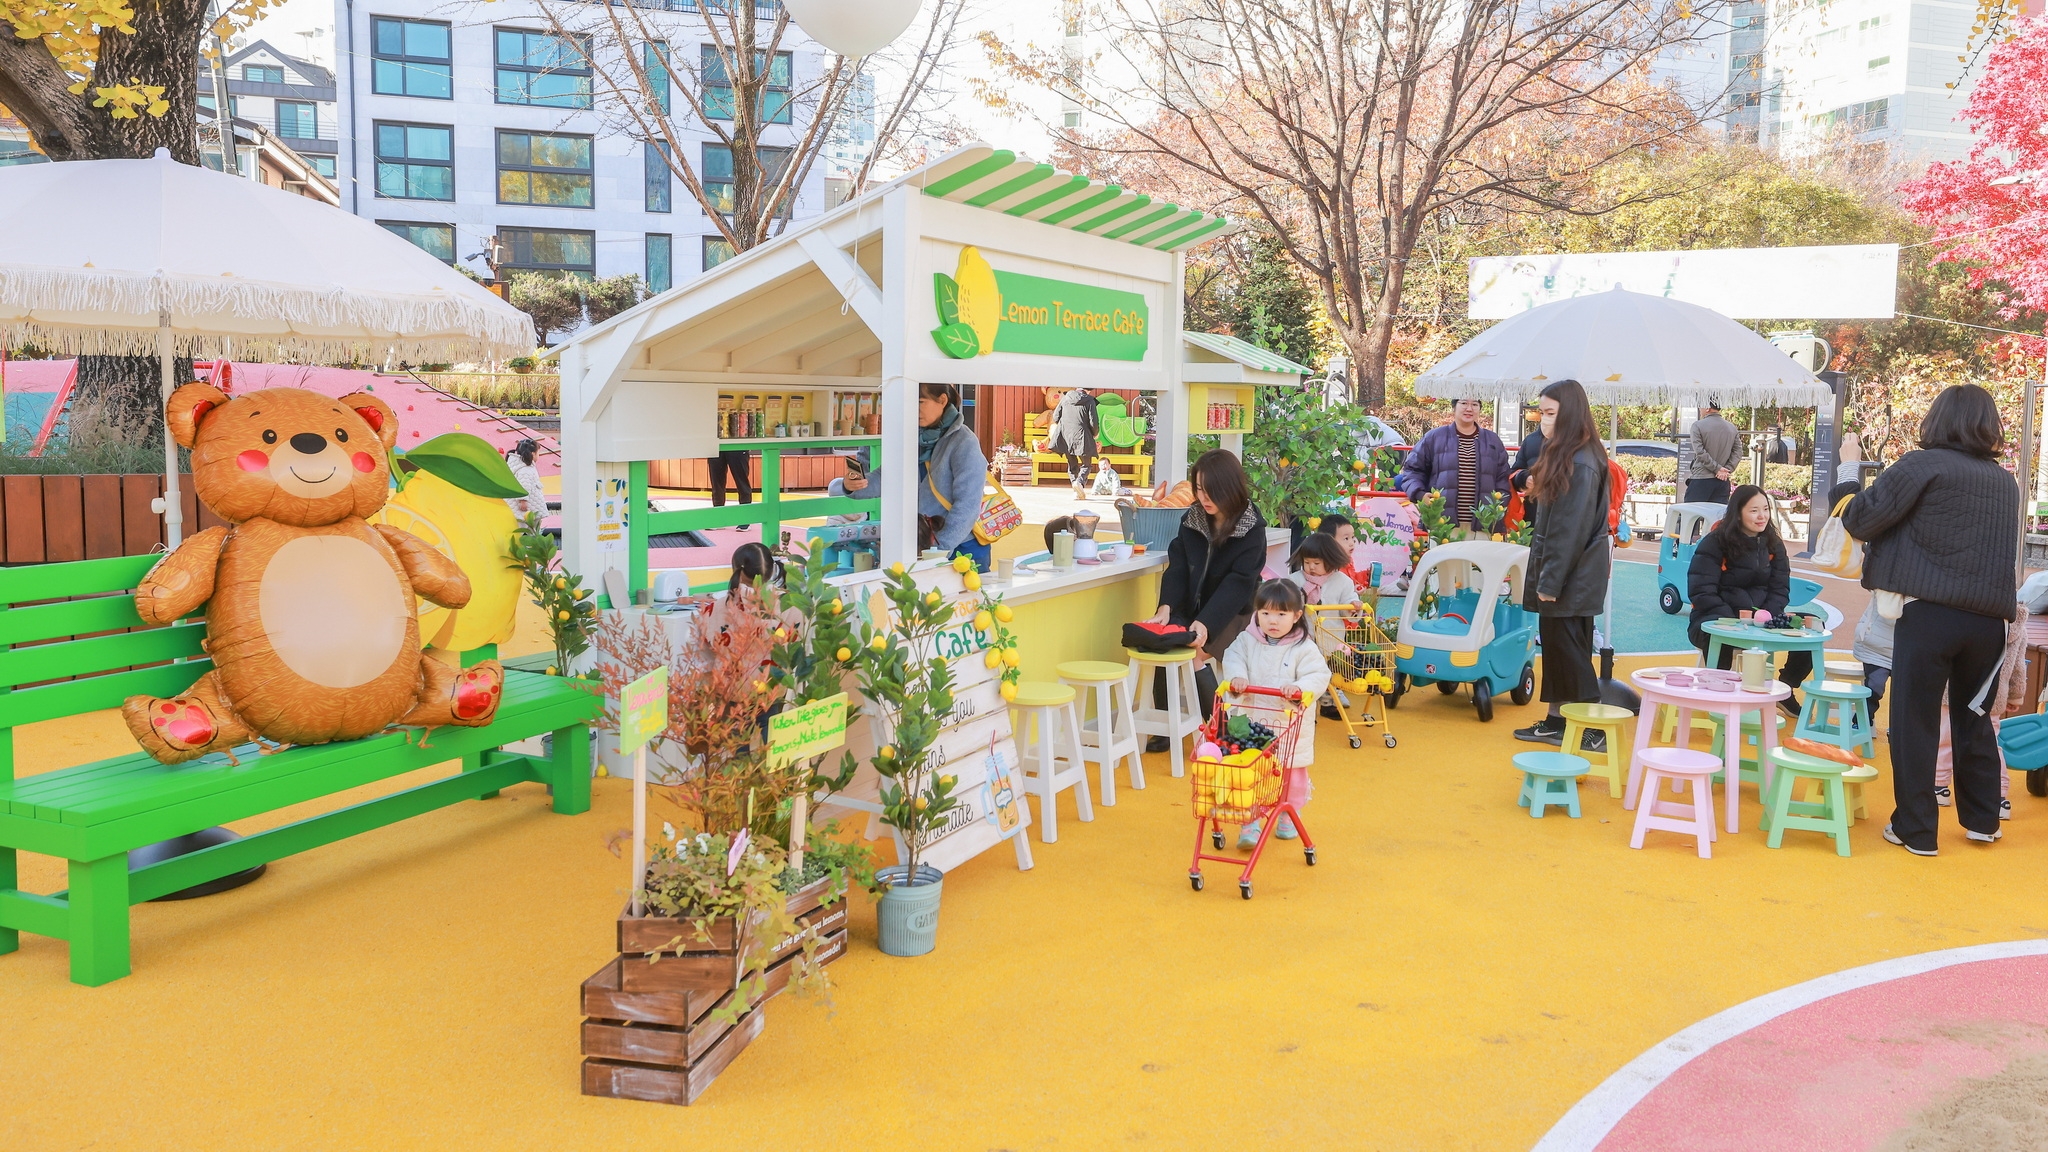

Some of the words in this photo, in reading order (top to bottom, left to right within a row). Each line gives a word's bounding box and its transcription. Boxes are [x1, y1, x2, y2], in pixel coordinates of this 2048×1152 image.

[998, 293, 1048, 325] Lemon
[1052, 300, 1109, 332] Terrace
[1112, 308, 1144, 335] Cafe
[935, 621, 988, 660] Cafe
[952, 698, 976, 732] you
